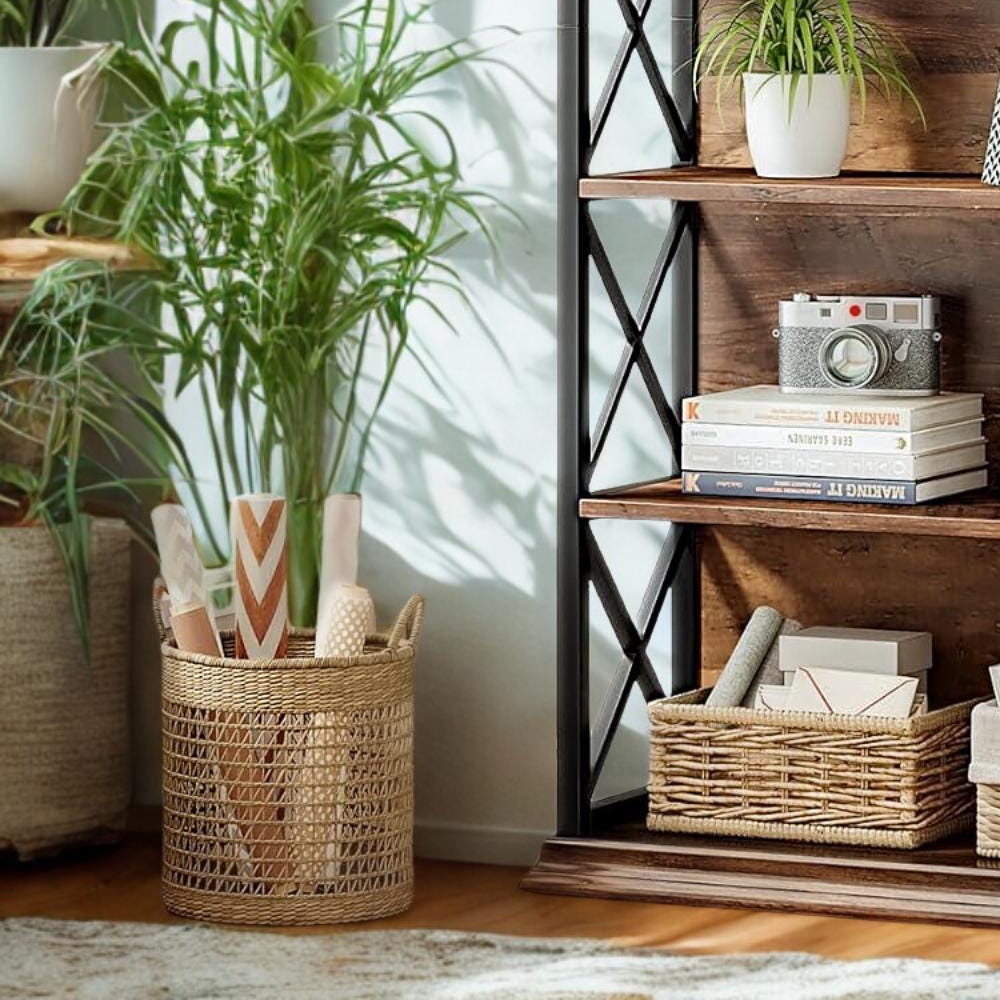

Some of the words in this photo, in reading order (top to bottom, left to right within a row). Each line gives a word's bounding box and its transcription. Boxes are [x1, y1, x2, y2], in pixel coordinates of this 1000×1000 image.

[824, 410, 839, 423] IT
[843, 410, 900, 426] MAKING
[827, 482, 842, 497] IT
[845, 484, 906, 499] MAKING
